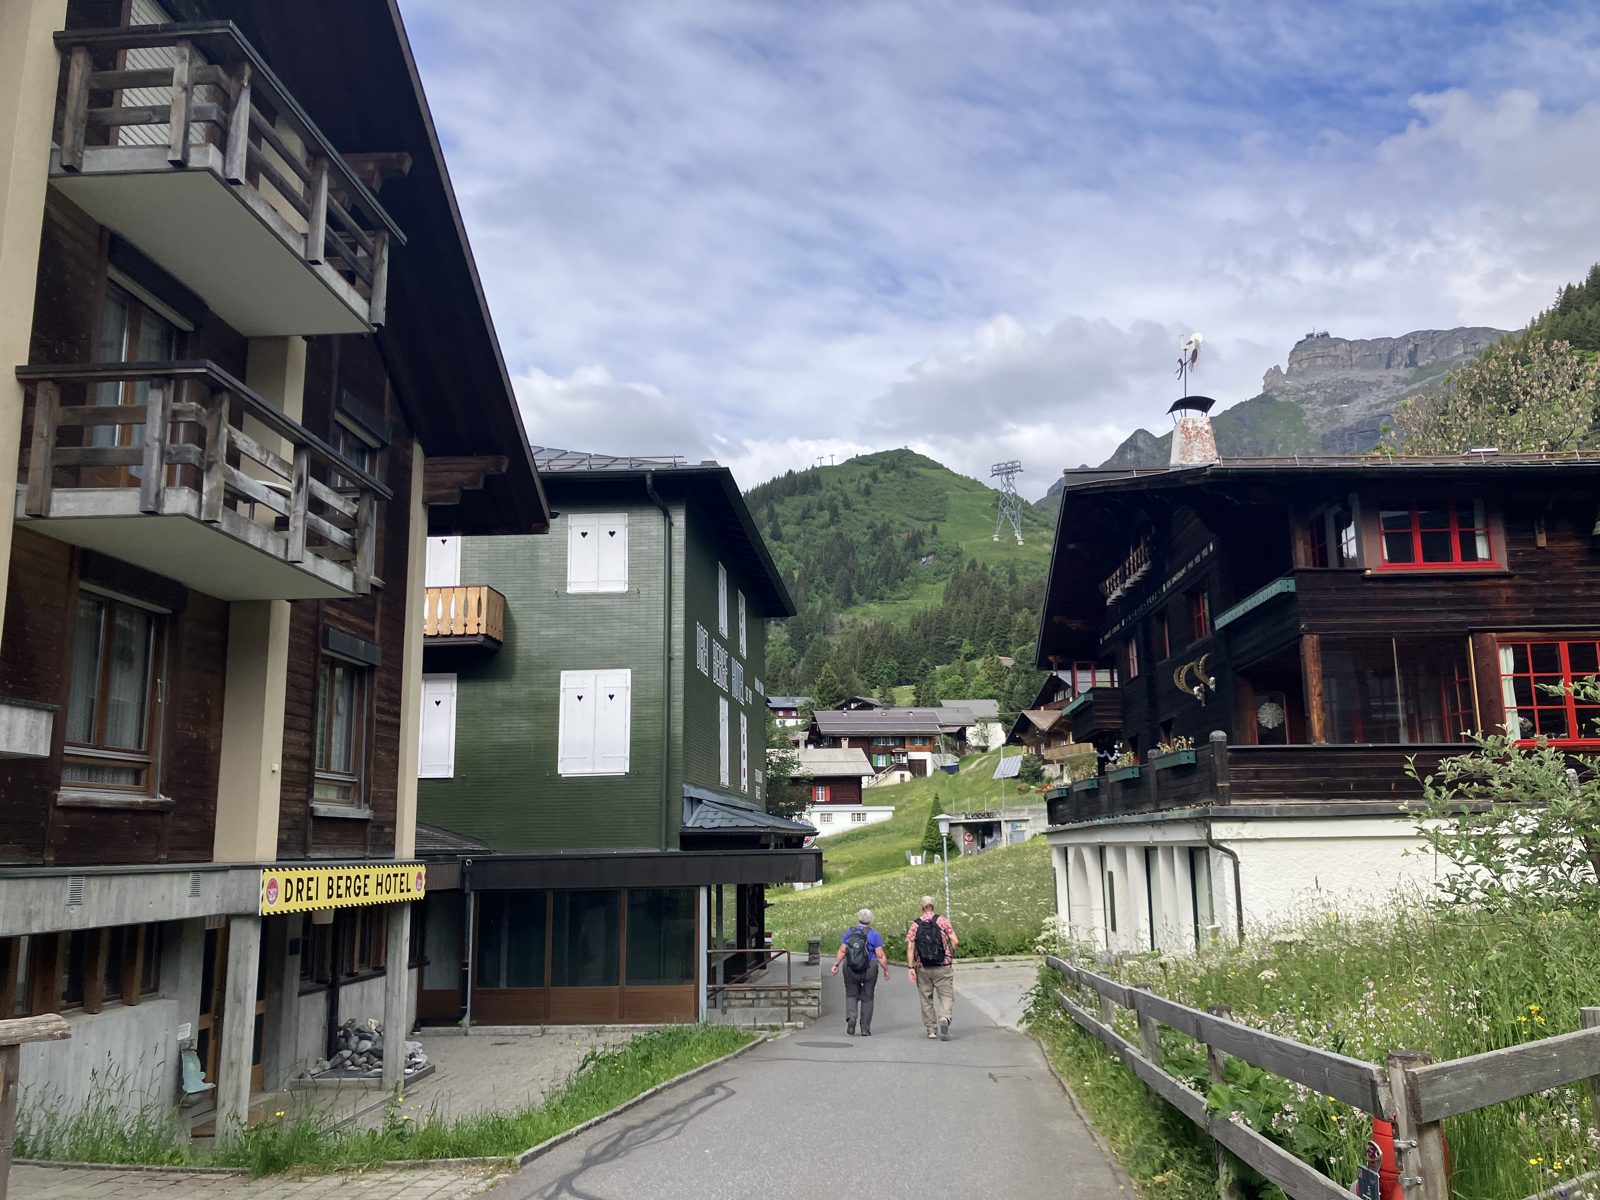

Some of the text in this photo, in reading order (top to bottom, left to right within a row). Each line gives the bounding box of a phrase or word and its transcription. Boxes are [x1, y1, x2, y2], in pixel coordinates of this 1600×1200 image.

[284, 872, 411, 903] DREI BERGE HOTEL
